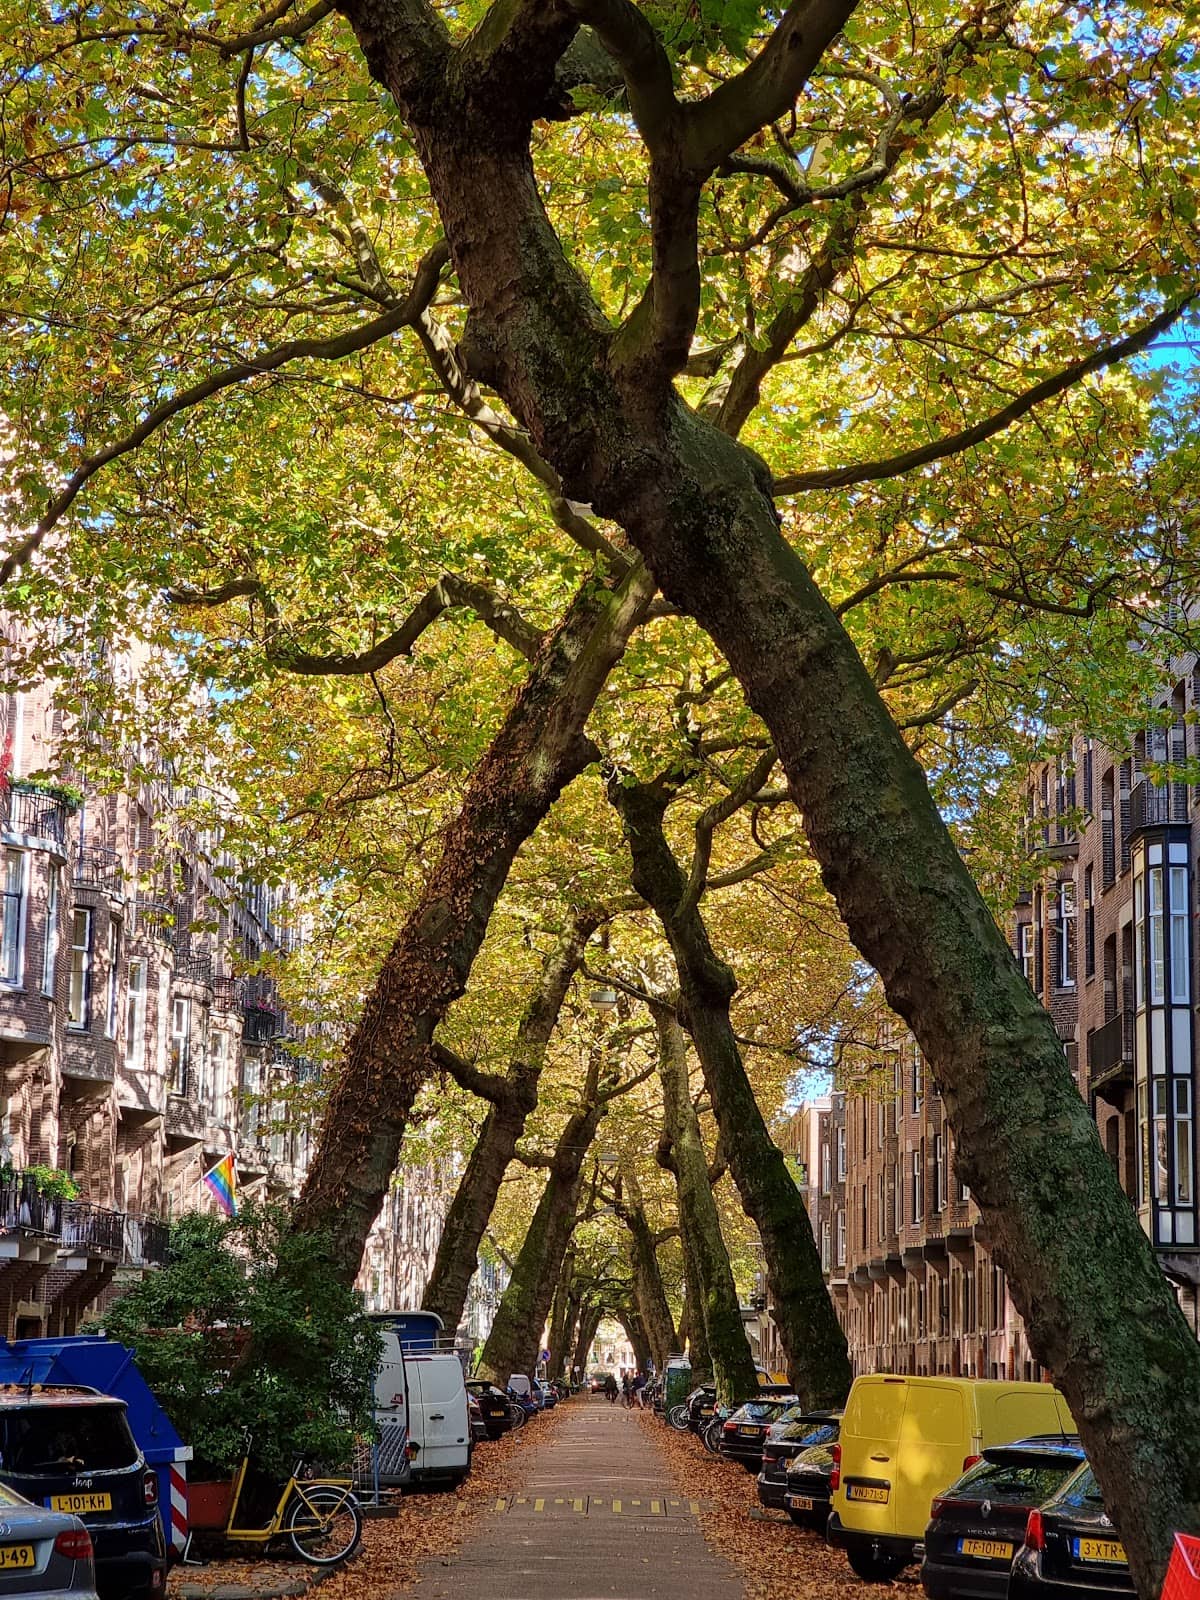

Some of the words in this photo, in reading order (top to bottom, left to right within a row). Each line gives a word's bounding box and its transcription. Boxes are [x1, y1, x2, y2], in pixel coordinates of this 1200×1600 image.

[854, 1486, 884, 1500] VNJ-71-S
[57, 1494, 106, 1511] L-101-KH
[967, 1541, 1007, 1556] TF-101-H
